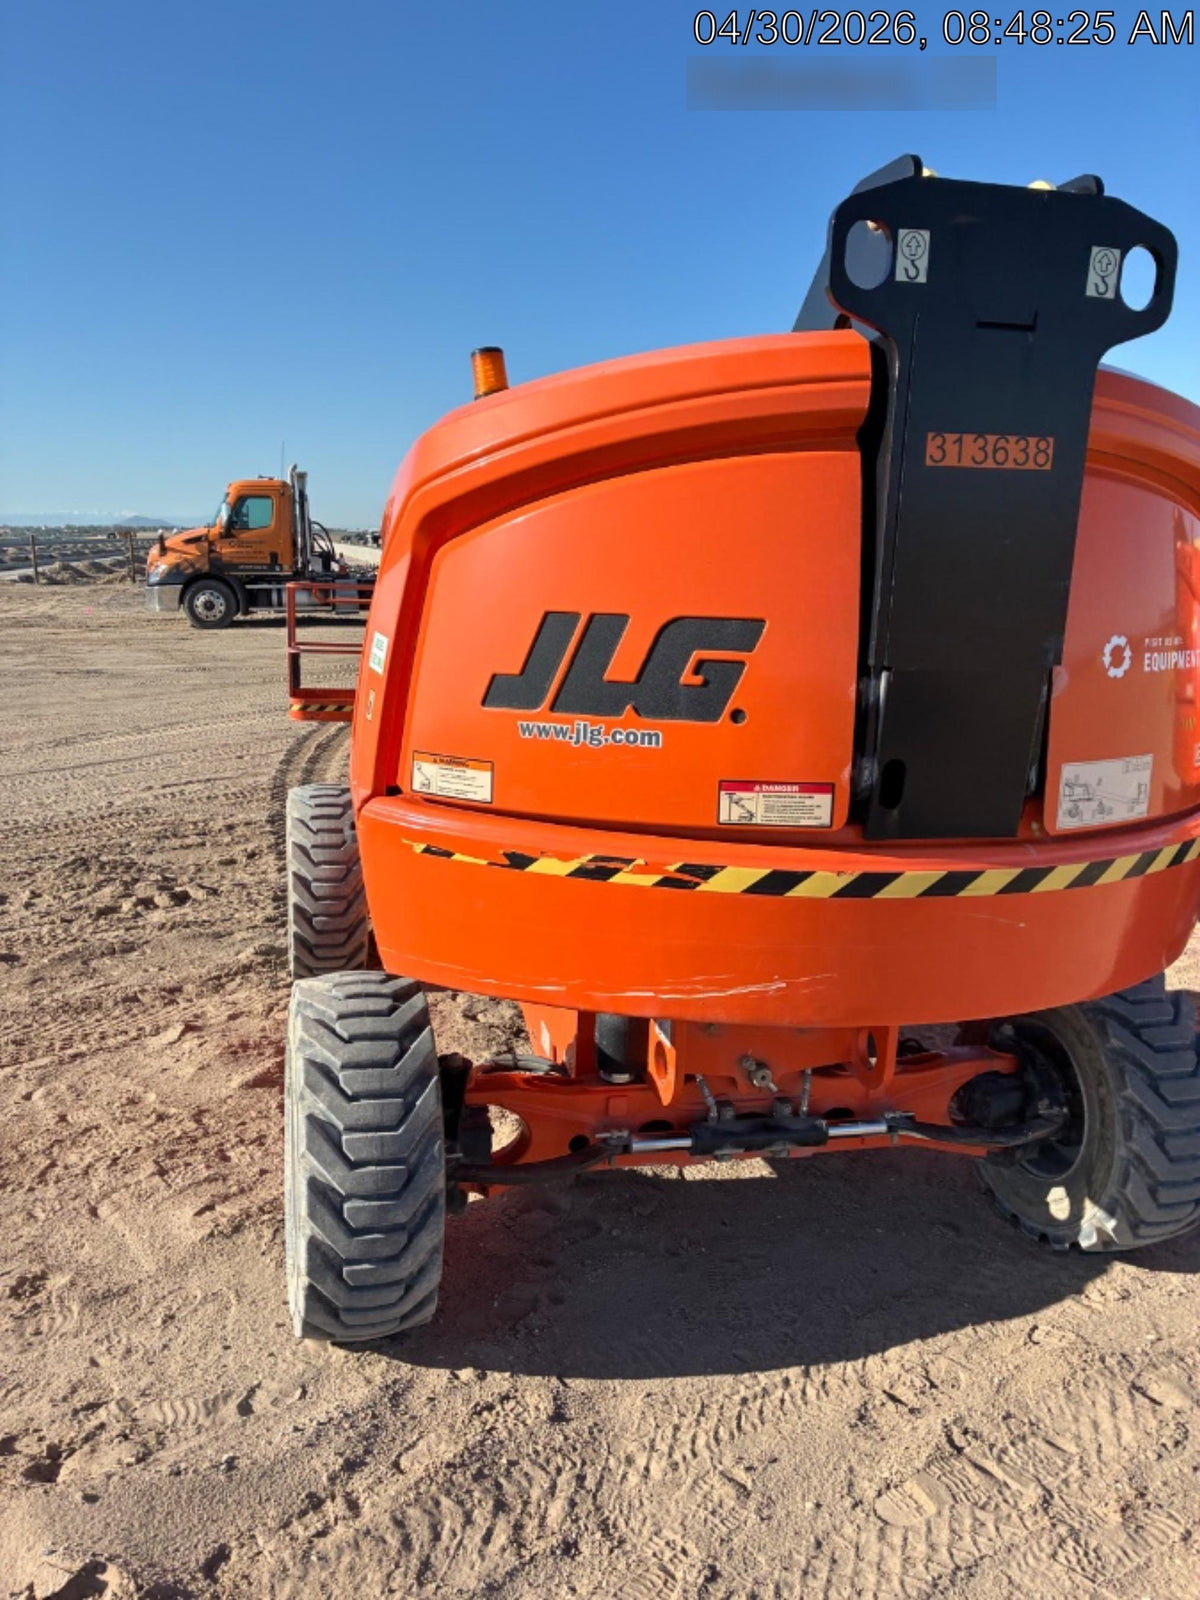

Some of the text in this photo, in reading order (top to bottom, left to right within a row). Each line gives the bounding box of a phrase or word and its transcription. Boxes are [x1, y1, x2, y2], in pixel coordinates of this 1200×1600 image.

[929, 433, 1050, 468] 313638
[517, 720, 662, 748] www.jlg.com
[762, 783, 799, 792] DANGER
